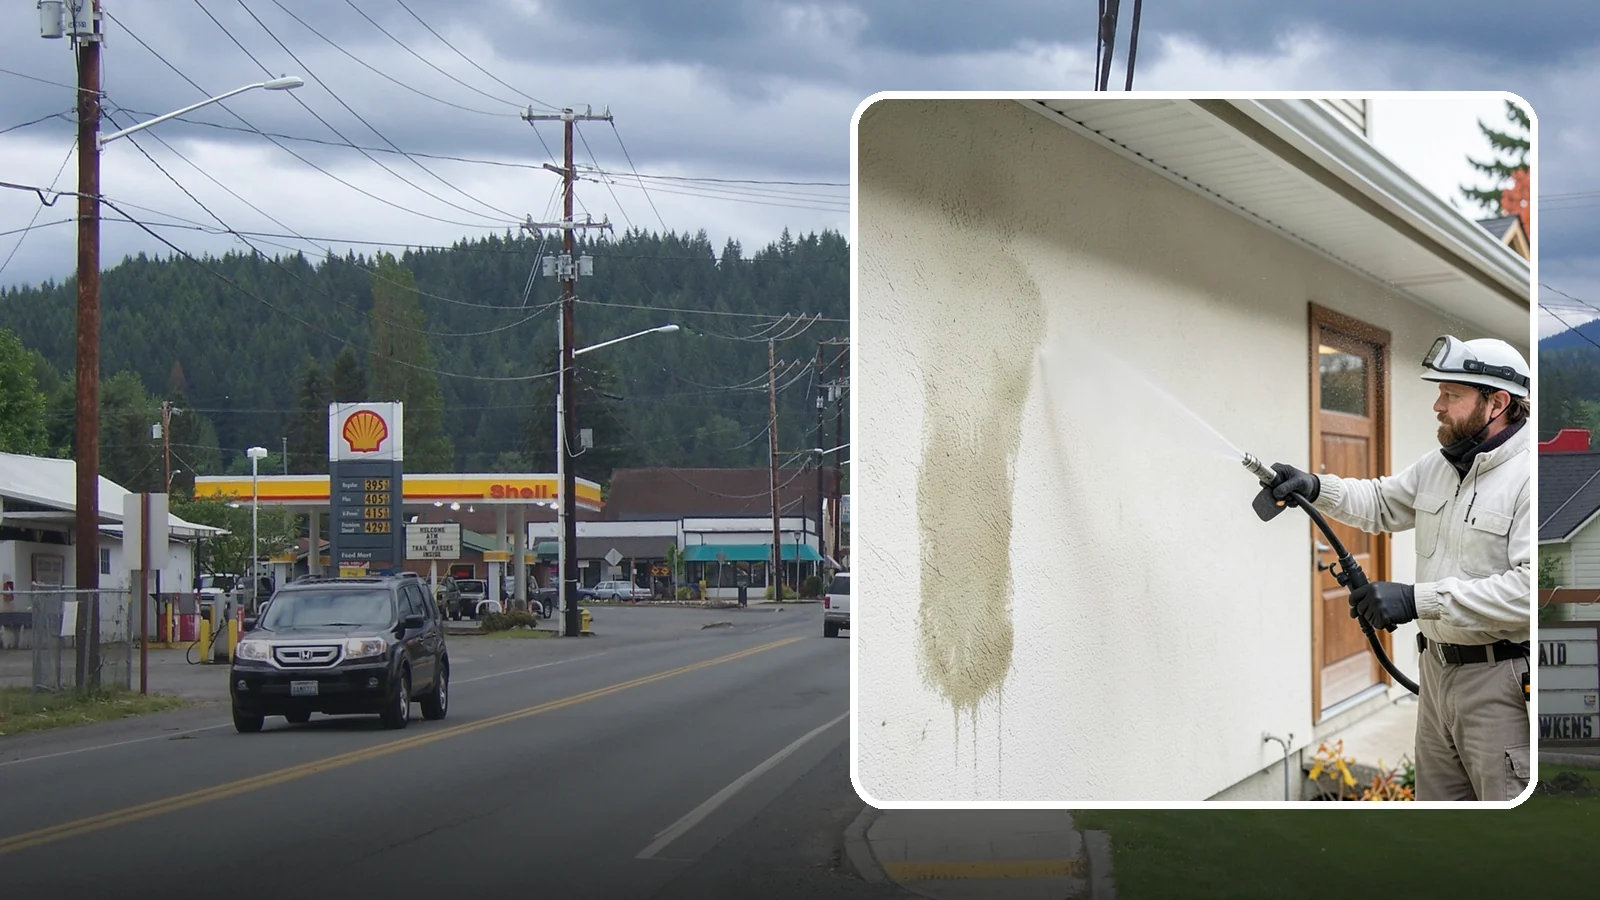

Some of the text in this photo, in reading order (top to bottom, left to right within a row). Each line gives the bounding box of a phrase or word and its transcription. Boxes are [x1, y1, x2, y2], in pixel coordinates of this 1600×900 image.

[366, 480, 383, 490] 395
[490, 484, 547, 499] Shell
[365, 494, 383, 504] 405
[365, 508, 383, 518] 415
[366, 522, 383, 532] 429
